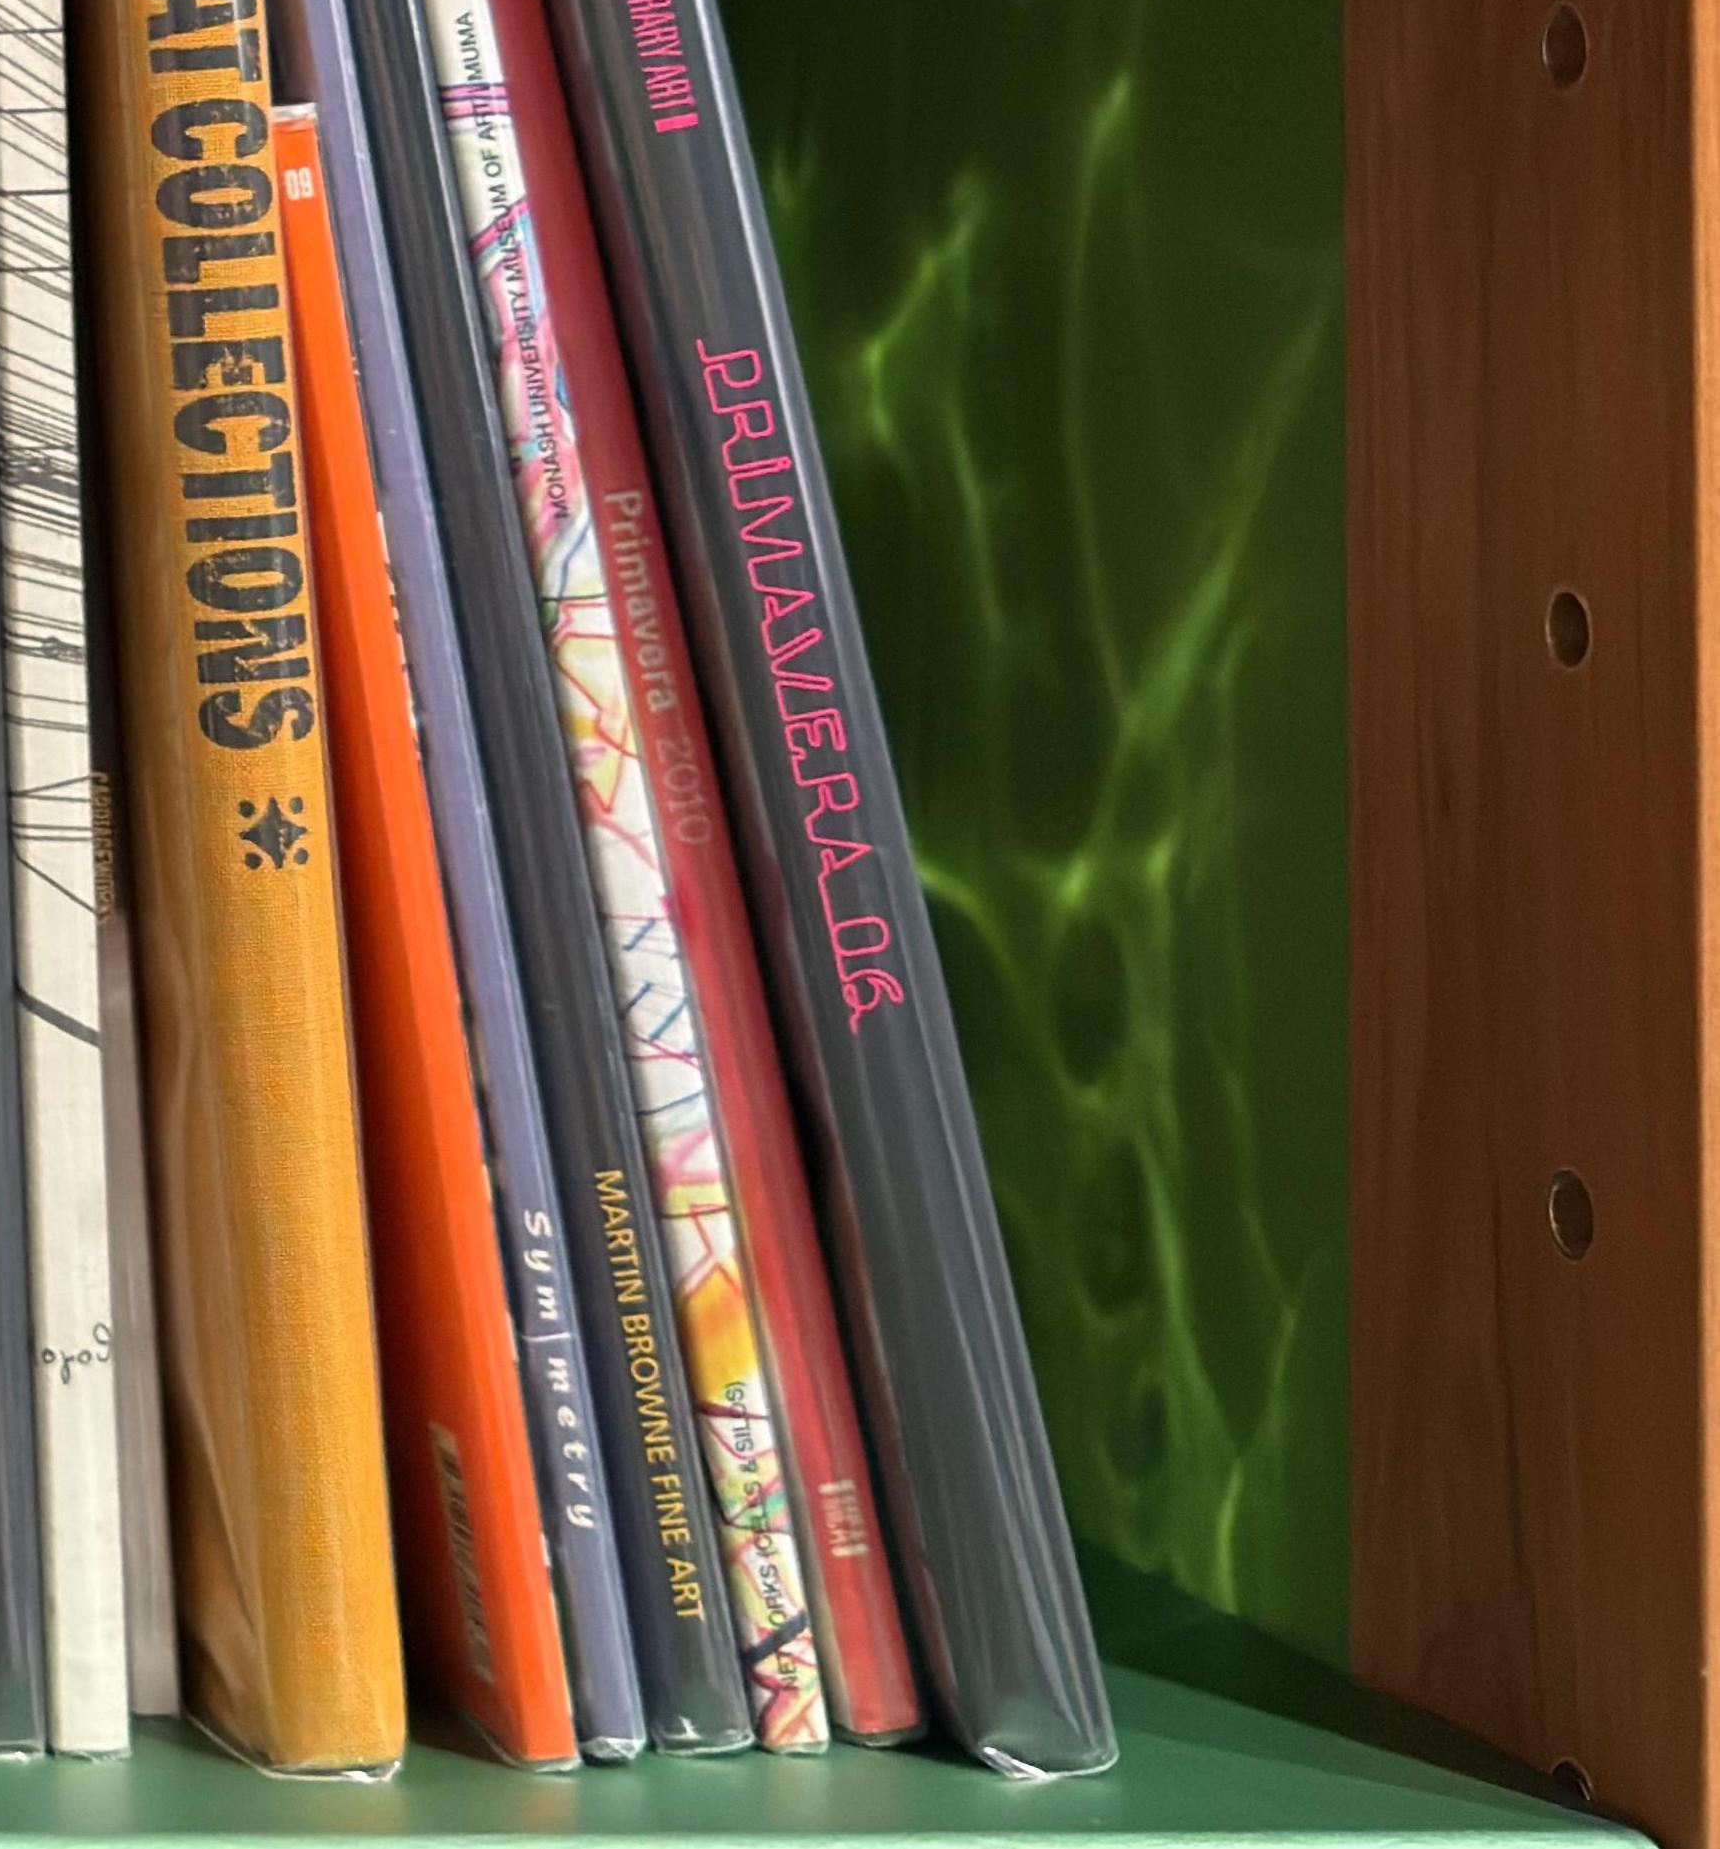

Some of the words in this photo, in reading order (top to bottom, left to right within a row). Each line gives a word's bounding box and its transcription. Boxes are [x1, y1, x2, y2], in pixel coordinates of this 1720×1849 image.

[641, 63, 696, 114] ART
[150, 96, 317, 754] COLLECTIONS
[604, 489, 683, 714] Primavera
[655, 734, 716, 847] 2010
[697, 340, 874, 877] PRIMAVERA
[593, 1169, 646, 1305] MARTIN
[619, 1313, 675, 1465] BROWNE
[649, 1474, 693, 1547] FINE
[664, 1556, 706, 1622] ART
